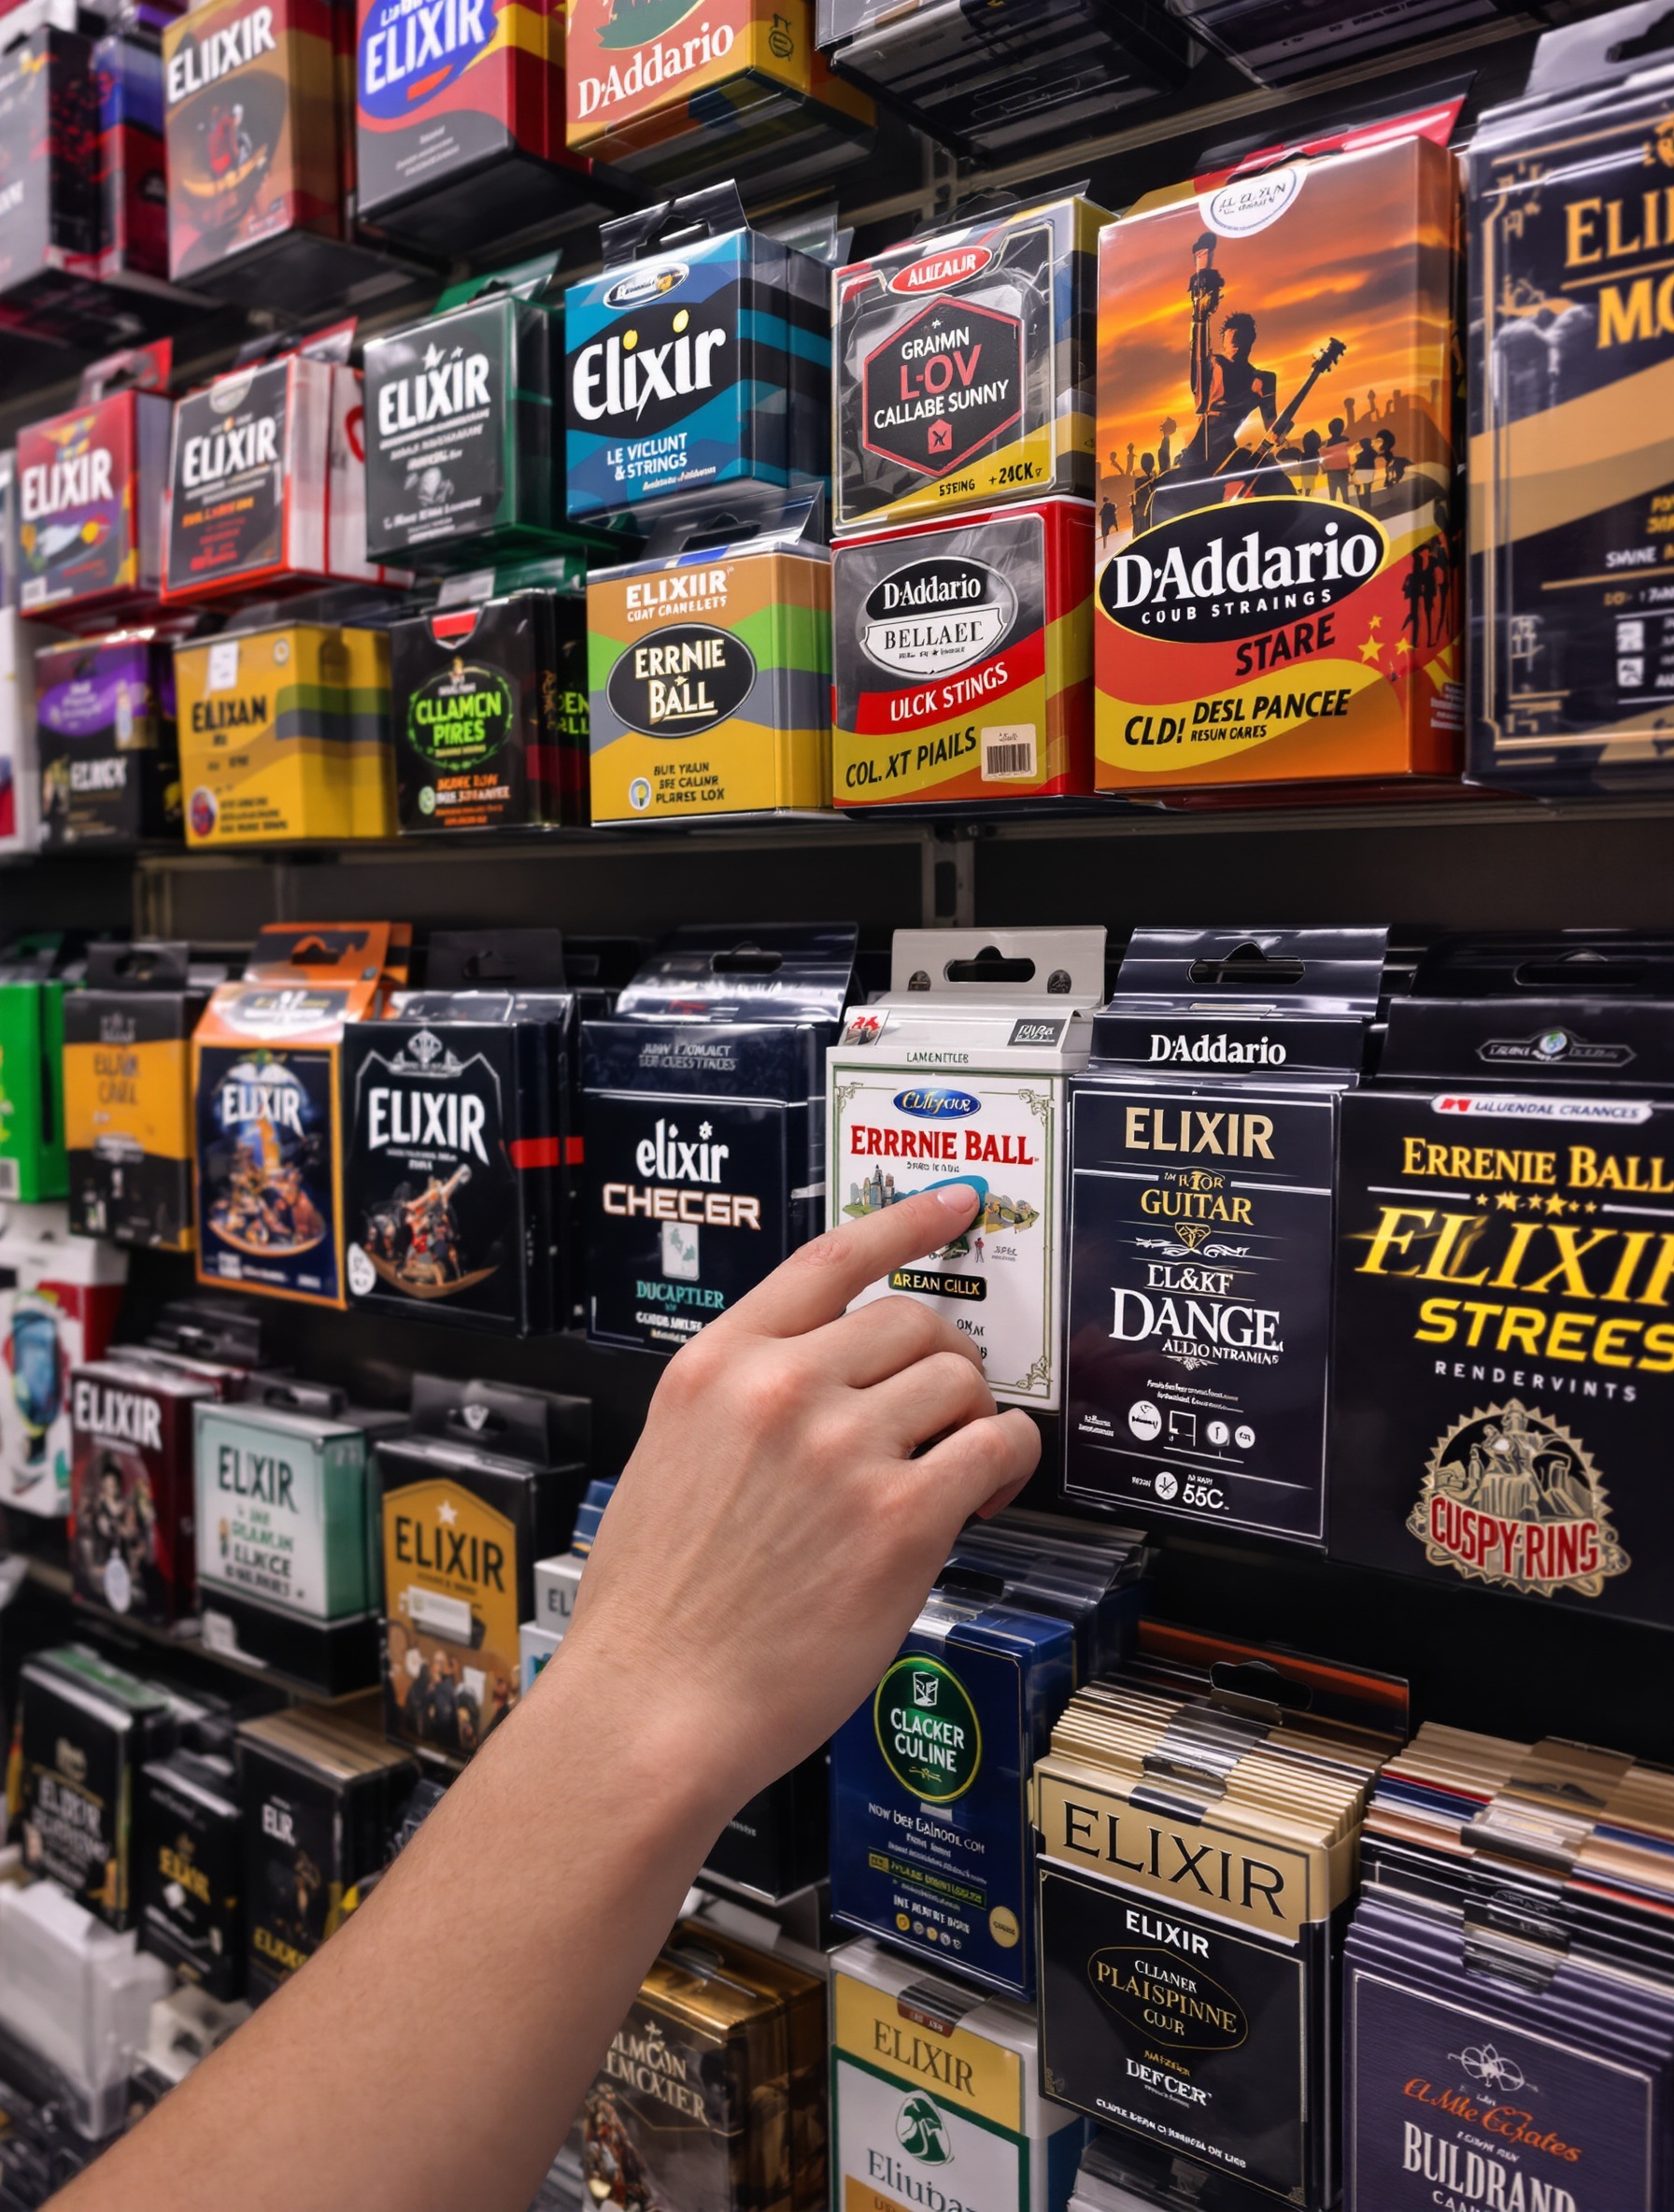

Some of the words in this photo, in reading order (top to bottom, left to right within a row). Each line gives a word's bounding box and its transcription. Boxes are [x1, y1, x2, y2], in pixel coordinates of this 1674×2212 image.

[365, 0, 486, 95] ELIXIR
[377, 353, 491, 436] ELIXIR
[573, 309, 727, 422] Elixir
[873, 399, 944, 429] CALLABE
[948, 379, 1009, 413] SUNNY
[182, 417, 278, 488] ELIXIR
[21, 448, 113, 521] ELIXIR
[1142, 606, 1198, 625] COUB
[1211, 588, 1332, 617] STRAINGS
[635, 638, 727, 680] ERRNIE
[1235, 612, 1336, 676] STARE
[649, 679, 717, 724] BALL
[943, 661, 1009, 709] STINGS
[1192, 698, 1245, 725] DESL
[1252, 688, 1352, 722] PANCEE
[886, 750, 913, 780] XT
[1149, 1033, 1286, 1066] D'Addario
[222, 1083, 306, 1141] ELIXIR
[369, 1086, 489, 1167] ELIXIR
[1125, 1106, 1275, 1160] ELIXIR
[636, 1118, 729, 1184] elixir
[851, 1124, 958, 1160] ERRRNIE
[964, 1129, 1033, 1166] BALL
[1401, 1136, 1557, 1184] ERRENIE
[1568, 1145, 1674, 1194] BALL
[1141, 1188, 1255, 1226] GUITAR
[1413, 1297, 1674, 1373] STREES
[1435, 1360, 1638, 1402] RENDERVINTS
[74, 1380, 163, 1453] ELIXIR
[395, 1514, 505, 1594] ELIXIR
[1524, 1522, 1598, 1581] RING
[889, 1706, 965, 1751] CLACKER
[894, 1732, 958, 1774] CULINE
[1062, 1799, 1288, 1921] ELIXIR
[1126, 1908, 1211, 1959] ELIXIR
[873, 2018, 976, 2097] ELIXIR
